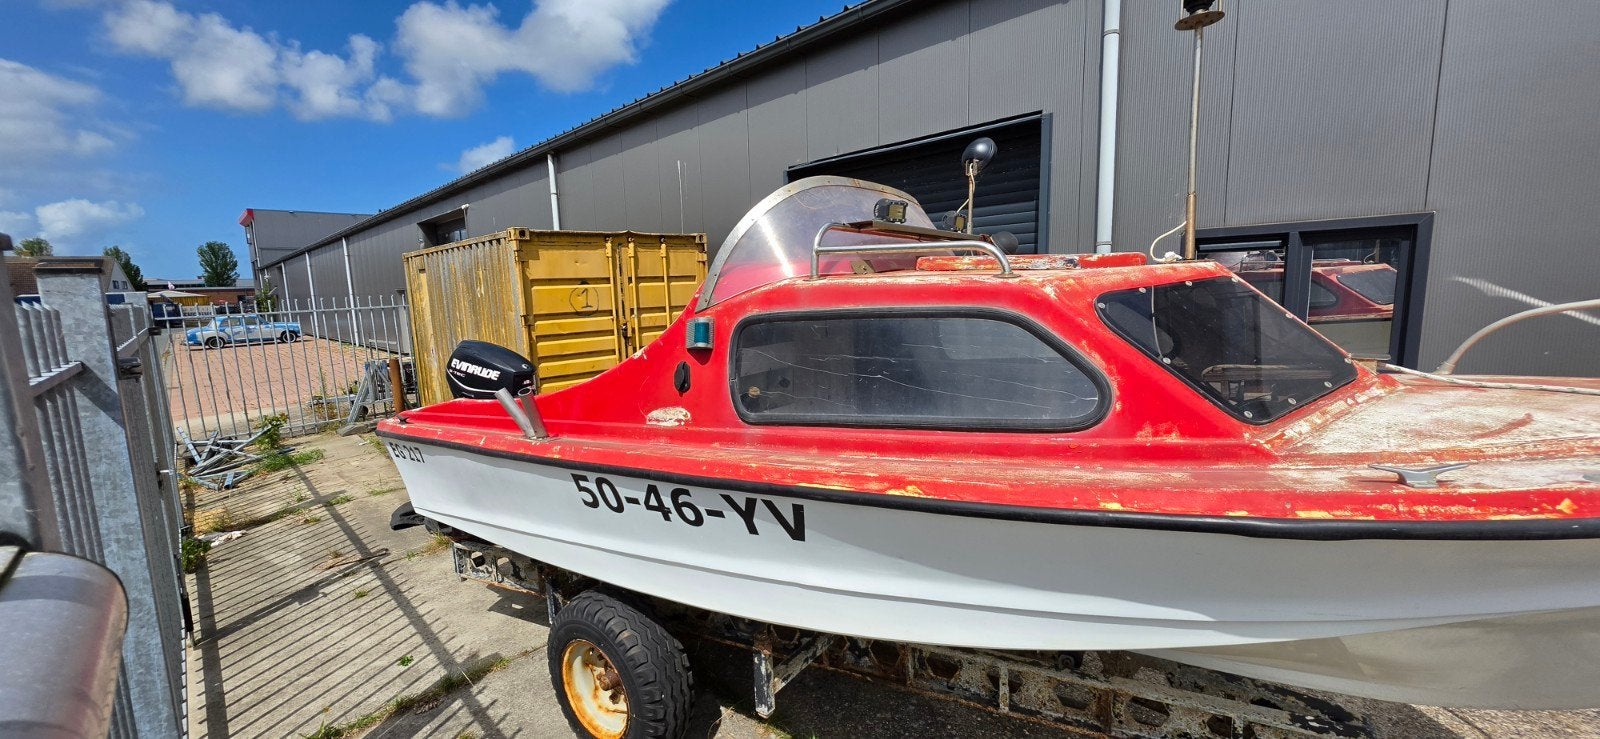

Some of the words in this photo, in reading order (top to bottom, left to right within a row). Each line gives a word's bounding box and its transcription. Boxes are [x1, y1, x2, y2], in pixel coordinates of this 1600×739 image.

[578, 287, 593, 309] 1
[451, 357, 501, 381] EVINRUDE
[388, 442, 406, 460] EG
[402, 444, 425, 463] 217
[570, 473, 806, 542] 50-46-YV
